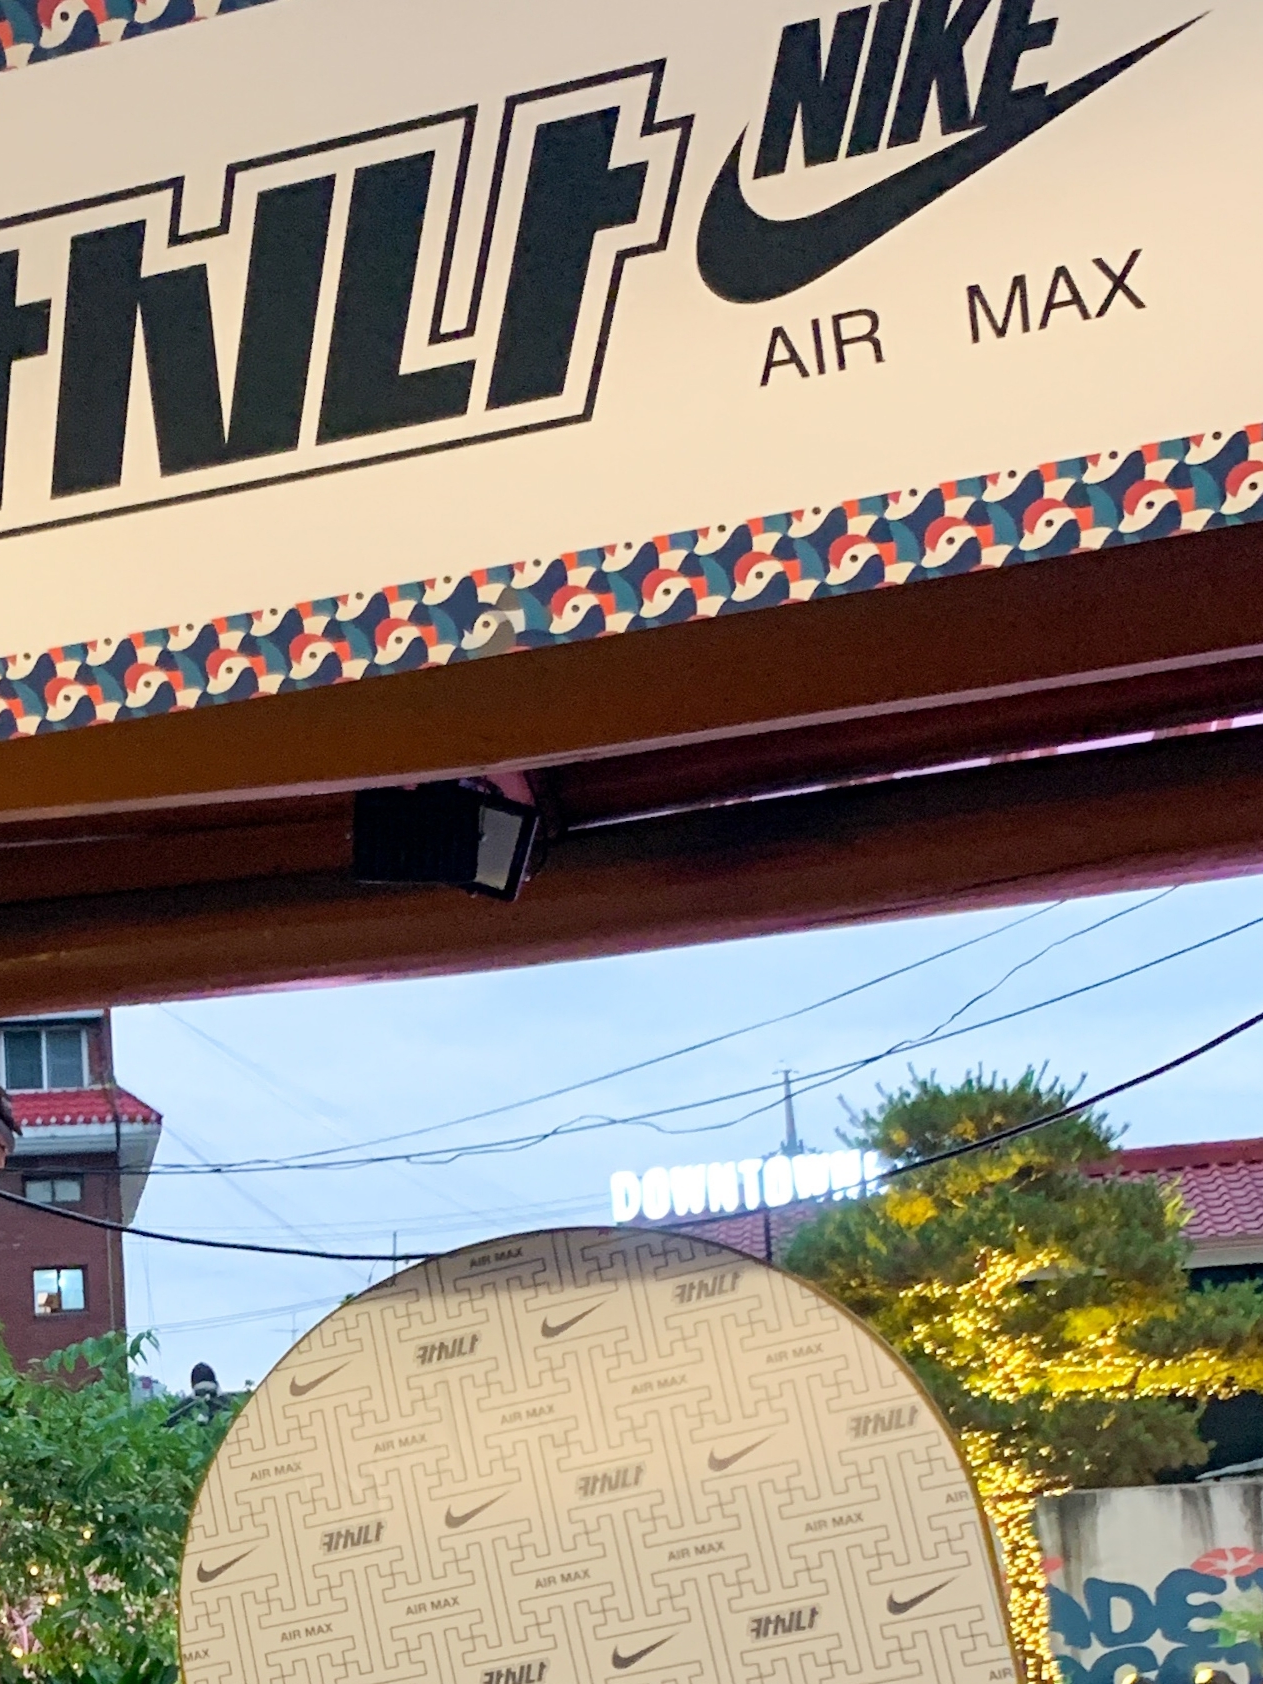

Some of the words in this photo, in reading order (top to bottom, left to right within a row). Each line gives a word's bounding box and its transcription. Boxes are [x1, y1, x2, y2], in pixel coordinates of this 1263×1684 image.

[753, 0, 1058, 180] NIKE
[760, 308, 885, 387] AIR
[966, 248, 1147, 344] MAX
[470, 1252, 491, 1269] AIR
[494, 1246, 523, 1262] MAX
[765, 1347, 793, 1364] AIR
[795, 1342, 824, 1357] MAX
[631, 1379, 658, 1395] AIR
[660, 1374, 688, 1389] MAX
[501, 1410, 523, 1426] AIR
[526, 1404, 555, 1419] MAX
[374, 1438, 397, 1454] AIR
[399, 1432, 428, 1448] MAX
[250, 1466, 273, 1481] AIR
[275, 1461, 302, 1477] MAX
[804, 1517, 831, 1534] AIR
[833, 1512, 864, 1528] MAX
[667, 1546, 693, 1562] AIR
[694, 1541, 725, 1557] MAX
[535, 1574, 561, 1589] AIR
[563, 1569, 591, 1584] MAX
[405, 1601, 432, 1616] AIR
[434, 1596, 460, 1611] MAX
[280, 1628, 305, 1643] AIR
[306, 1623, 333, 1638] MAX
[183, 1648, 211, 1662] MAX
